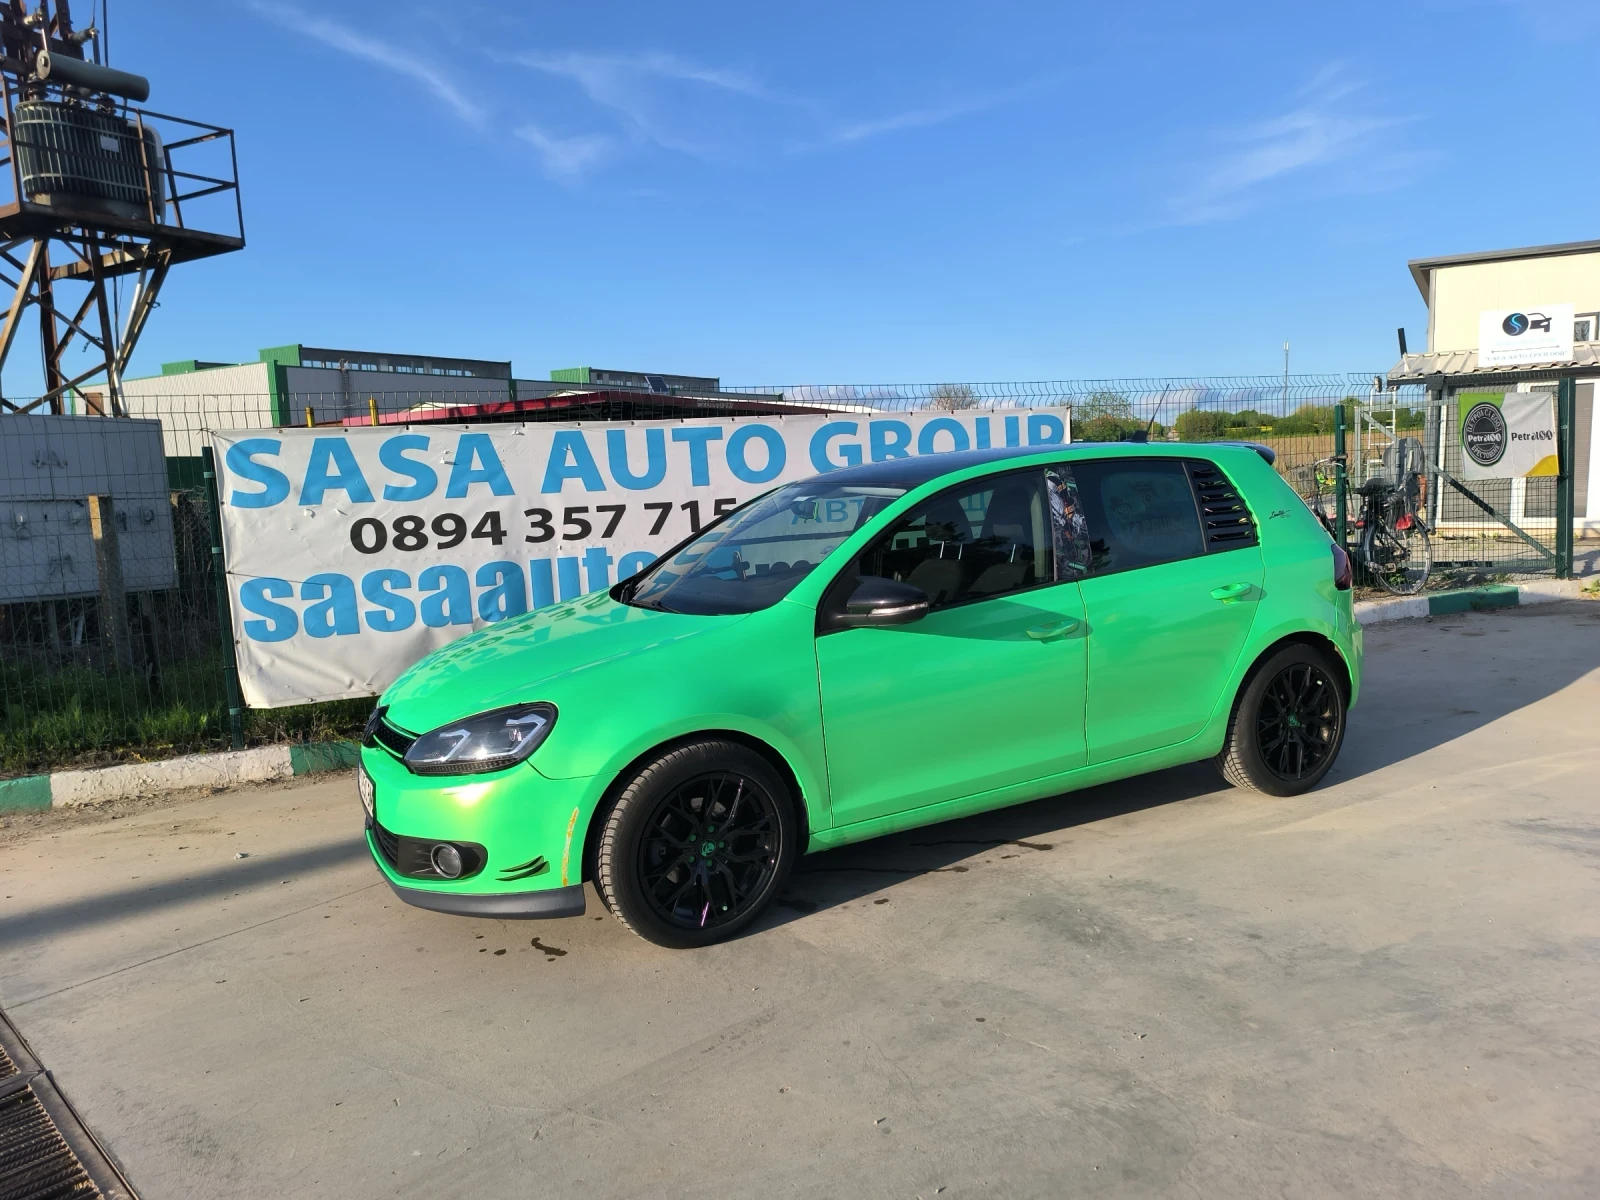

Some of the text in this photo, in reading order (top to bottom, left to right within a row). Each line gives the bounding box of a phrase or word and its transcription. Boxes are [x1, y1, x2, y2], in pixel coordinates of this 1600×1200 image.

[225, 414, 1065, 508] SASA AUTO GROUP
[350, 511, 507, 554] 0894
[524, 505, 626, 544] 357
